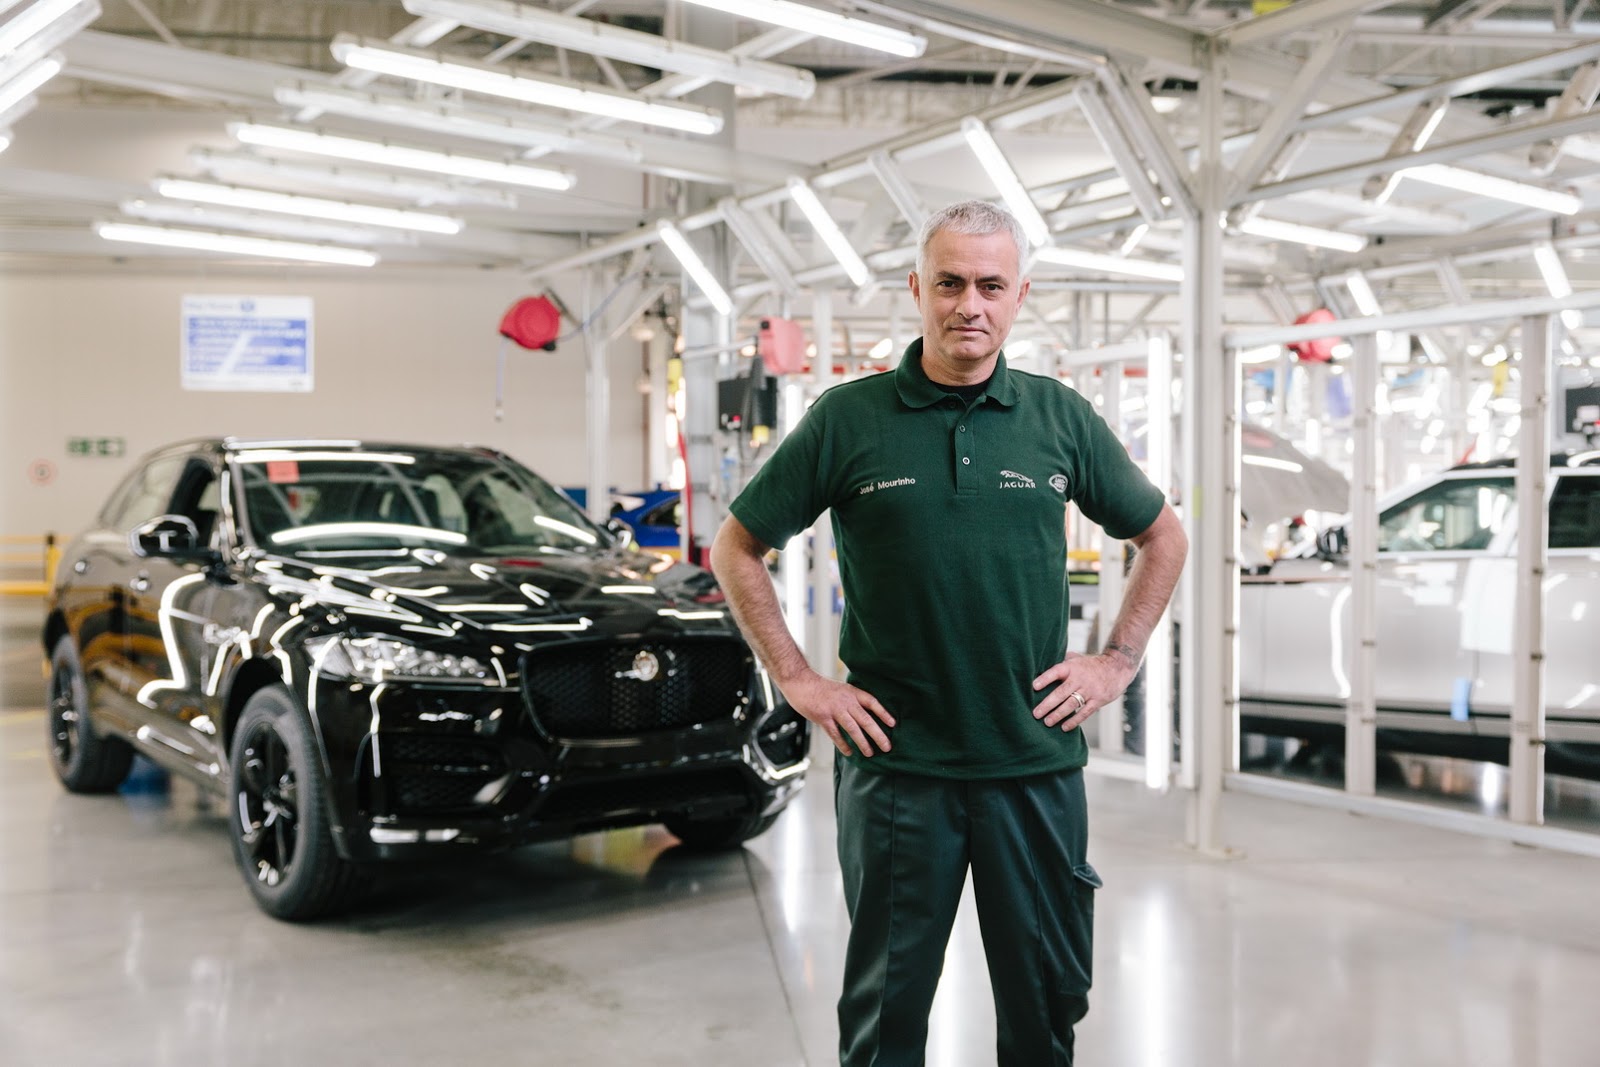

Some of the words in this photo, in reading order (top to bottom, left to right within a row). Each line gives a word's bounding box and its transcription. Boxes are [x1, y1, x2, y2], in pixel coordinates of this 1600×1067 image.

[860, 482, 875, 495] José
[877, 477, 916, 490] Mourinho
[1000, 481, 1036, 489] JAGUAR
